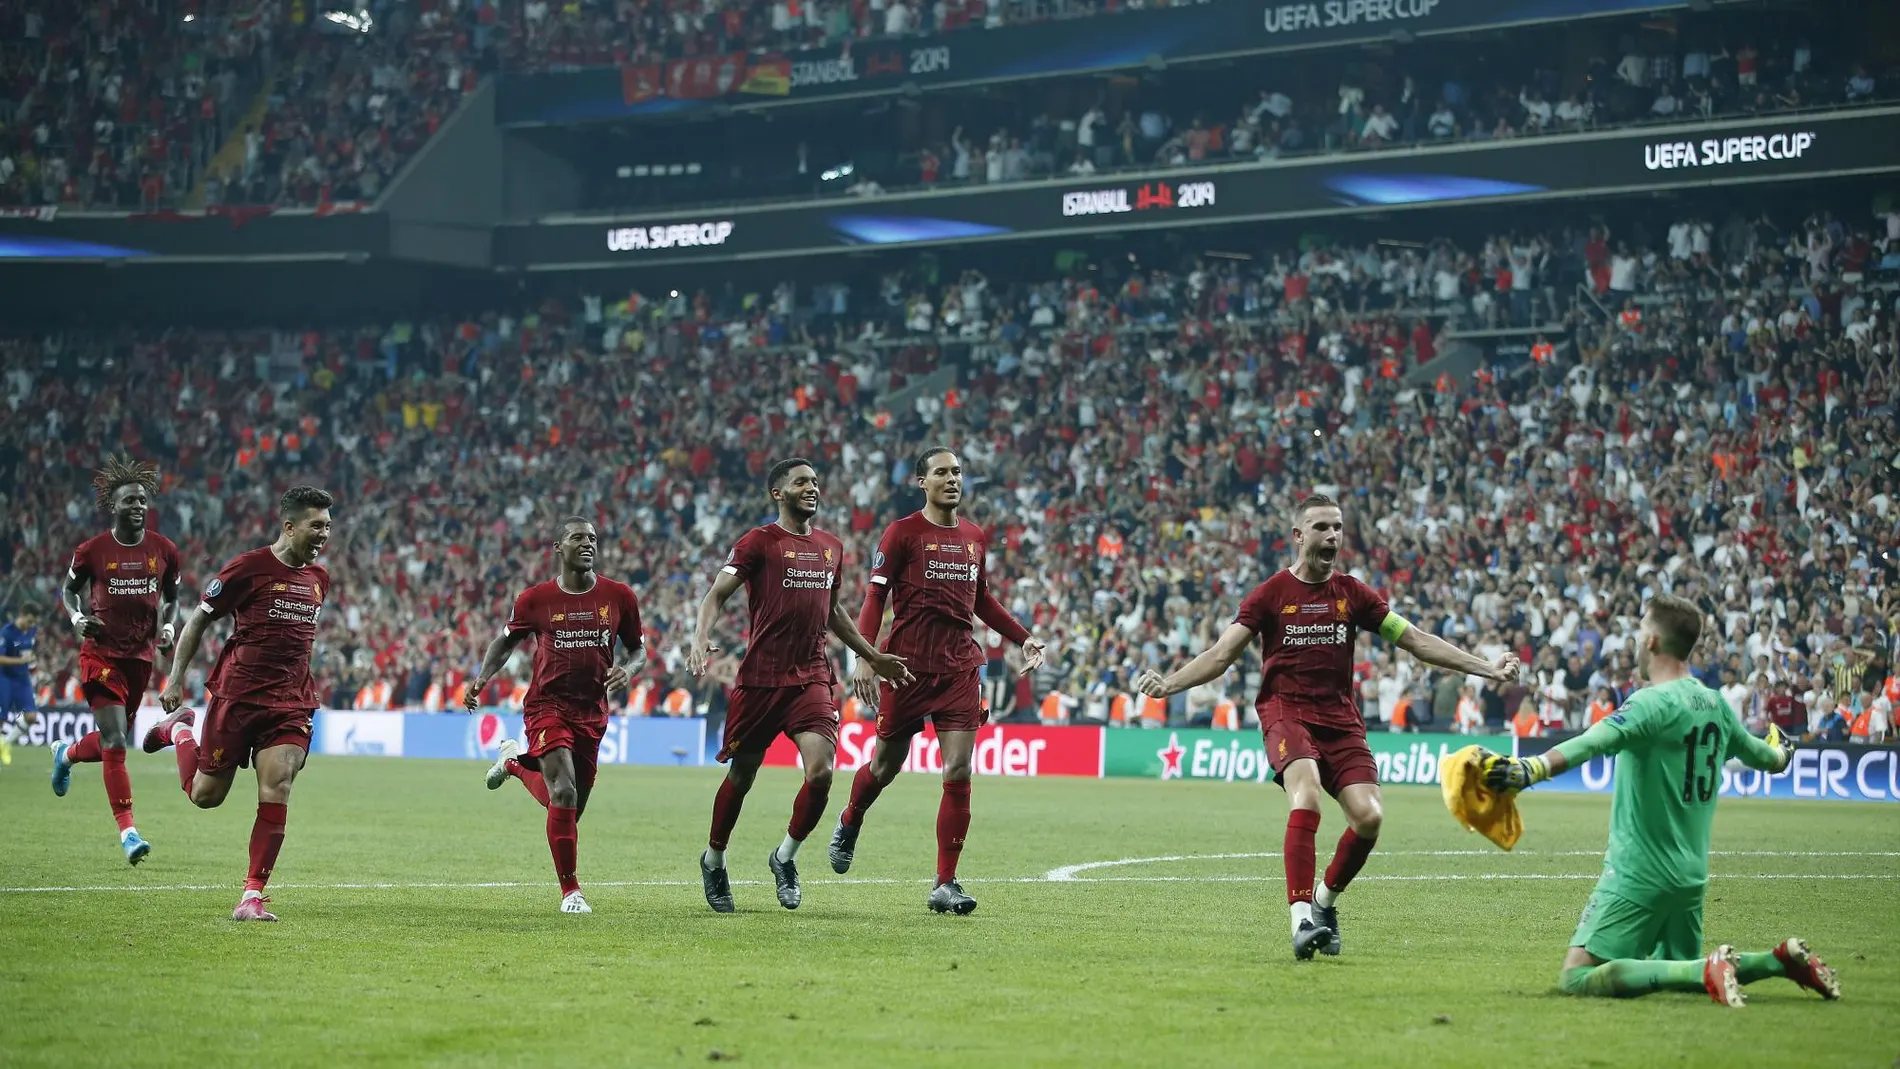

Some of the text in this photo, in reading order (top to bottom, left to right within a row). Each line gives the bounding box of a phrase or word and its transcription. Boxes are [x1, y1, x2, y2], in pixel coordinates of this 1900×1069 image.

[1264, 0, 1440, 33] UEFA SUPER CUP
[790, 57, 858, 87] STANBUL
[910, 47, 949, 74] 2019
[1644, 131, 1811, 170] UEFA SUPER CUP
[1062, 181, 1215, 216] ISTANBUL 2019
[607, 220, 732, 252] UEFA SUPER CUP
[928, 560, 968, 571] Standard
[786, 567, 826, 579] Standard
[924, 570, 968, 581] Chartered
[110, 577, 148, 586] Standard
[782, 578, 826, 589] Chartered
[107, 586, 148, 595] Chartered
[274, 598, 315, 613] Standard
[268, 608, 313, 624] Chartered
[555, 628, 599, 639] Standard
[1284, 623, 1335, 635] Standard
[554, 638, 600, 649] Chartered
[1282, 634, 1335, 646] Chartered
[1190, 739, 1270, 783] Enjoy
[1682, 721, 1722, 803] 13
